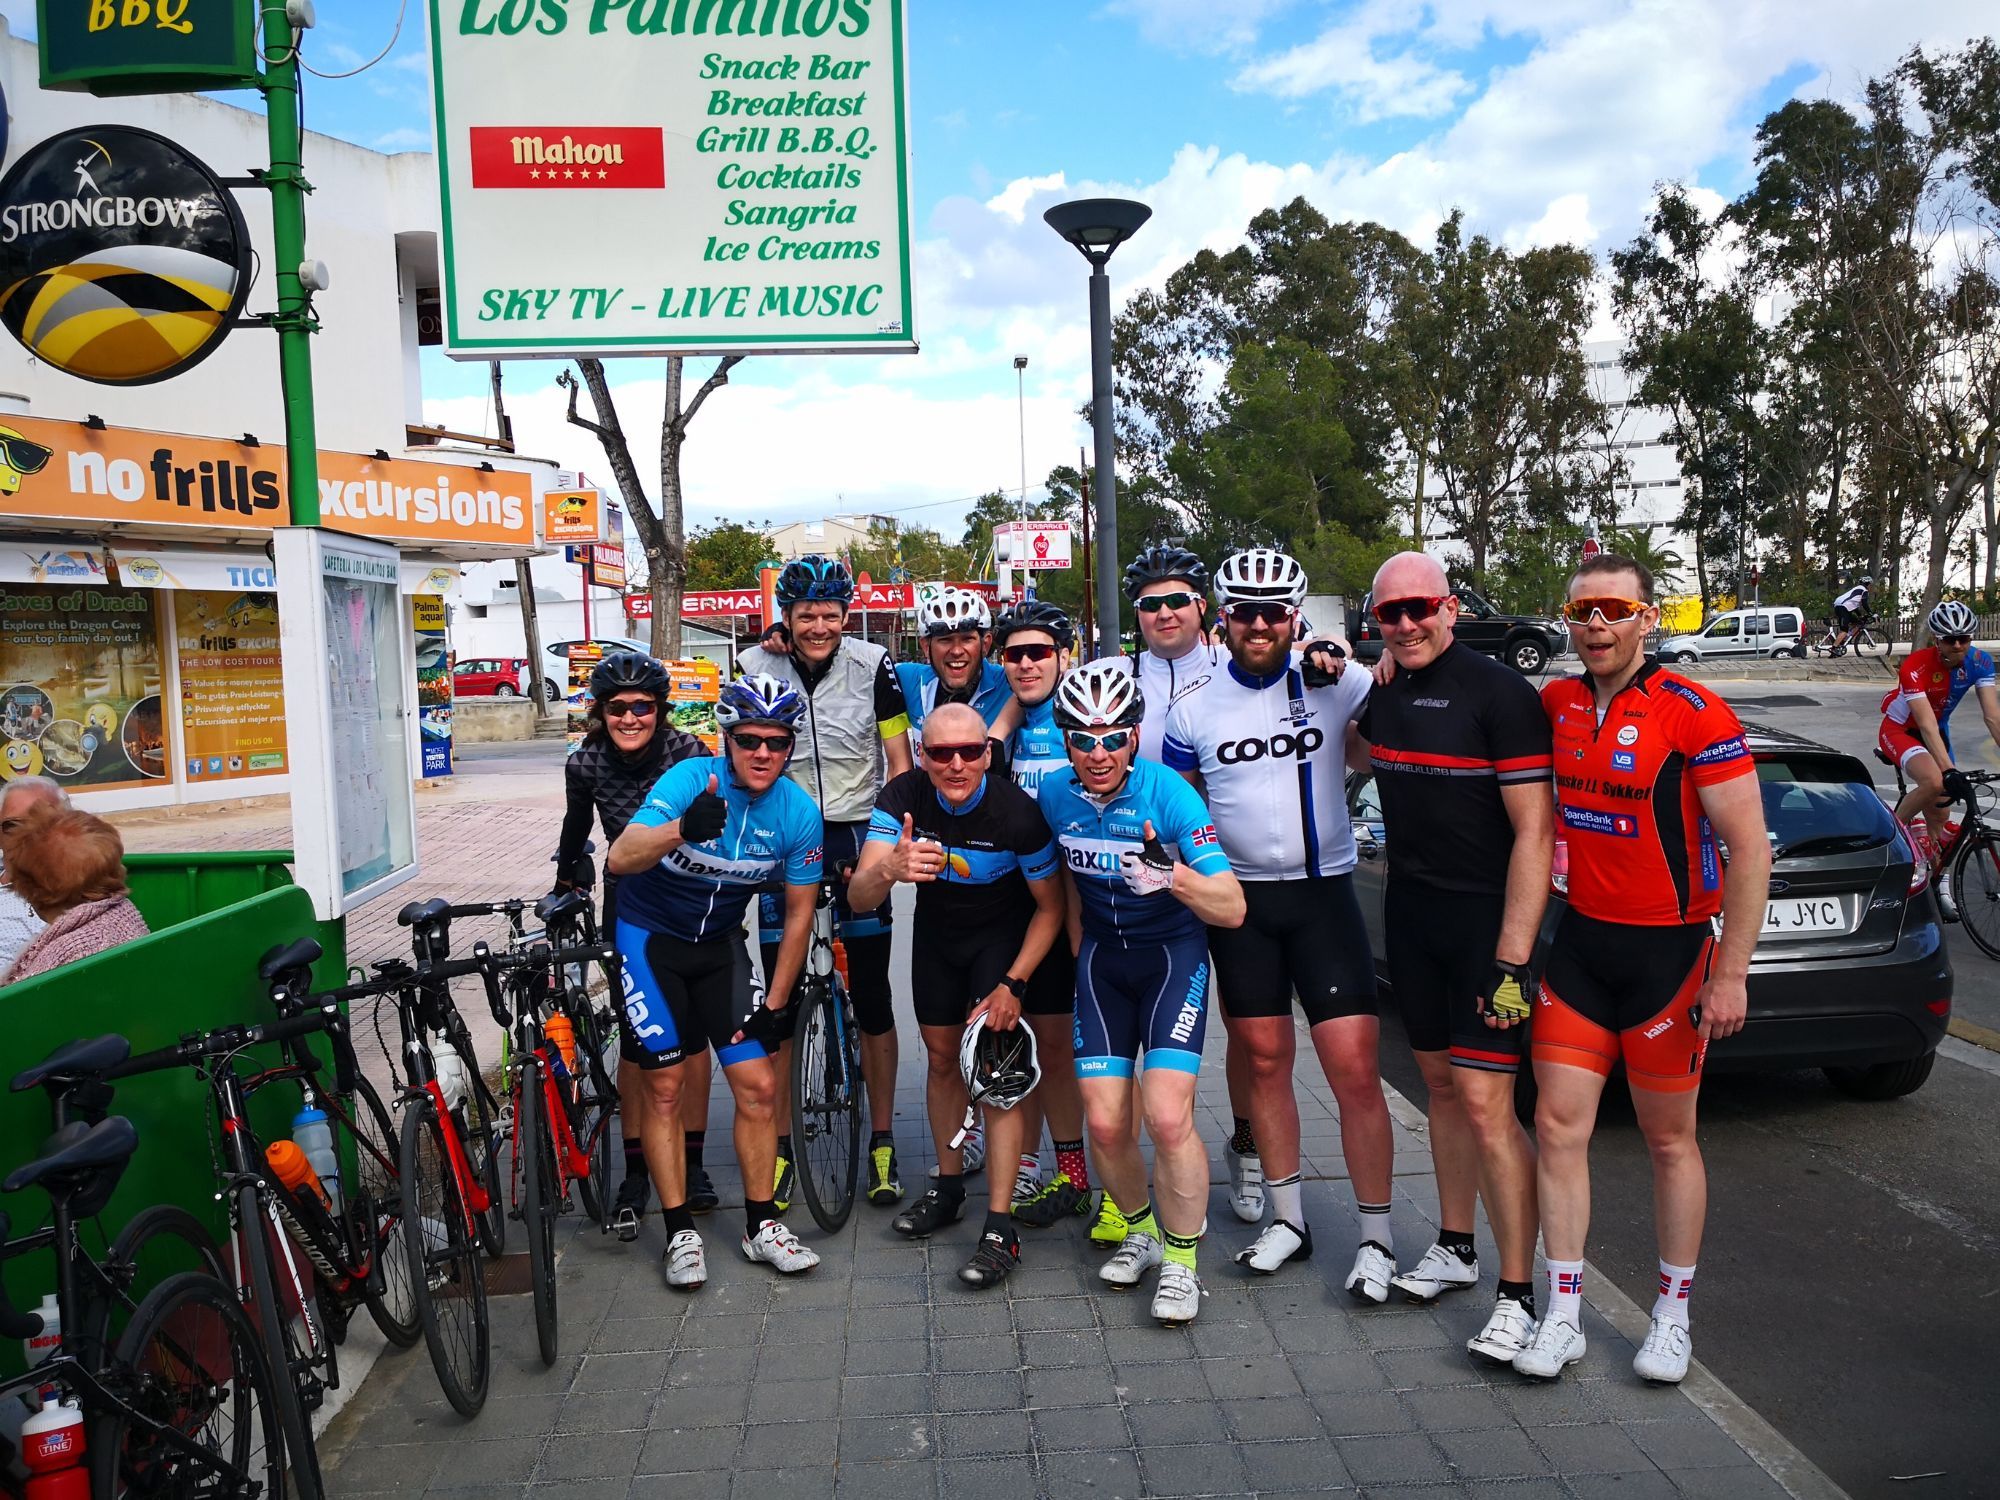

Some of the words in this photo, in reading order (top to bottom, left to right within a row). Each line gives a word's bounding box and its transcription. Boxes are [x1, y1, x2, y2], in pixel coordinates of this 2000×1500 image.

[88, 0, 194, 34] BBQ
[458, 0, 569, 36] Los
[699, 53, 800, 81] Snack
[808, 54, 871, 80] Bar
[707, 90, 867, 118] Breakfast
[510, 136, 624, 166] Mahou
[696, 126, 768, 154] Grill
[777, 126, 878, 159] B.B.Q.
[717, 163, 861, 190] Cocktails
[2, 197, 201, 243] STRONGBOW
[724, 199, 856, 232] Sangria
[703, 237, 747, 262] Ice
[758, 236, 880, 261] Creams
[478, 288, 560, 323] SKY
[569, 287, 624, 321] TV
[657, 286, 750, 319] LIVE
[757, 284, 883, 317] MUSIC
[68, 450, 146, 502] no
[150, 448, 281, 515] frills
[318, 476, 525, 530] xcursions
[324, 555, 351, 572] CAFETERIA
[353, 560, 362, 575] LOS
[363, 561, 385, 578] PALMITOS
[386, 563, 397, 579] BAR
[1584, 552, 1597, 560] STOP
[58, 591, 83, 611] of
[86, 591, 147, 611] Drach
[414, 603, 440, 612] Palma
[3, 621, 45, 632] Explore
[48, 621, 67, 630] the
[70, 620, 109, 632] Dragon
[111, 620, 142, 630] Caves
[13, 635, 32, 643] our
[35, 634, 55, 645] top
[58, 633, 90, 645] family
[93, 633, 112, 643] day
[114, 634, 133, 643] out
[179, 637, 199, 649] no
[200, 635, 237, 651] frills
[181, 659, 199, 667] THE
[202, 659, 222, 667] LOW
[225, 658, 249, 666] COST
[252, 657, 275, 665] TOUR
[194, 680, 215, 688] Value
[216, 679, 227, 687] for
[229, 679, 254, 688] money
[209, 692, 229, 702] gutes
[1216, 727, 1324, 766] coop
[426, 760, 446, 770] PARK
[1602, 781, 1652, 800] Sykkel
[1564, 807, 1613, 826] SpareBank
[1618, 819, 1628, 831] 1
[970, 840, 994, 848] DIADORA
[1791, 902, 1837, 927] JYC
[1170, 962, 1209, 1044] maxpulse
[1643, 1017, 1675, 1040] kalas
[658, 1050, 682, 1062] kalas
[1081, 1060, 1108, 1071] kalas
[42, 1441, 69, 1454] TINE
